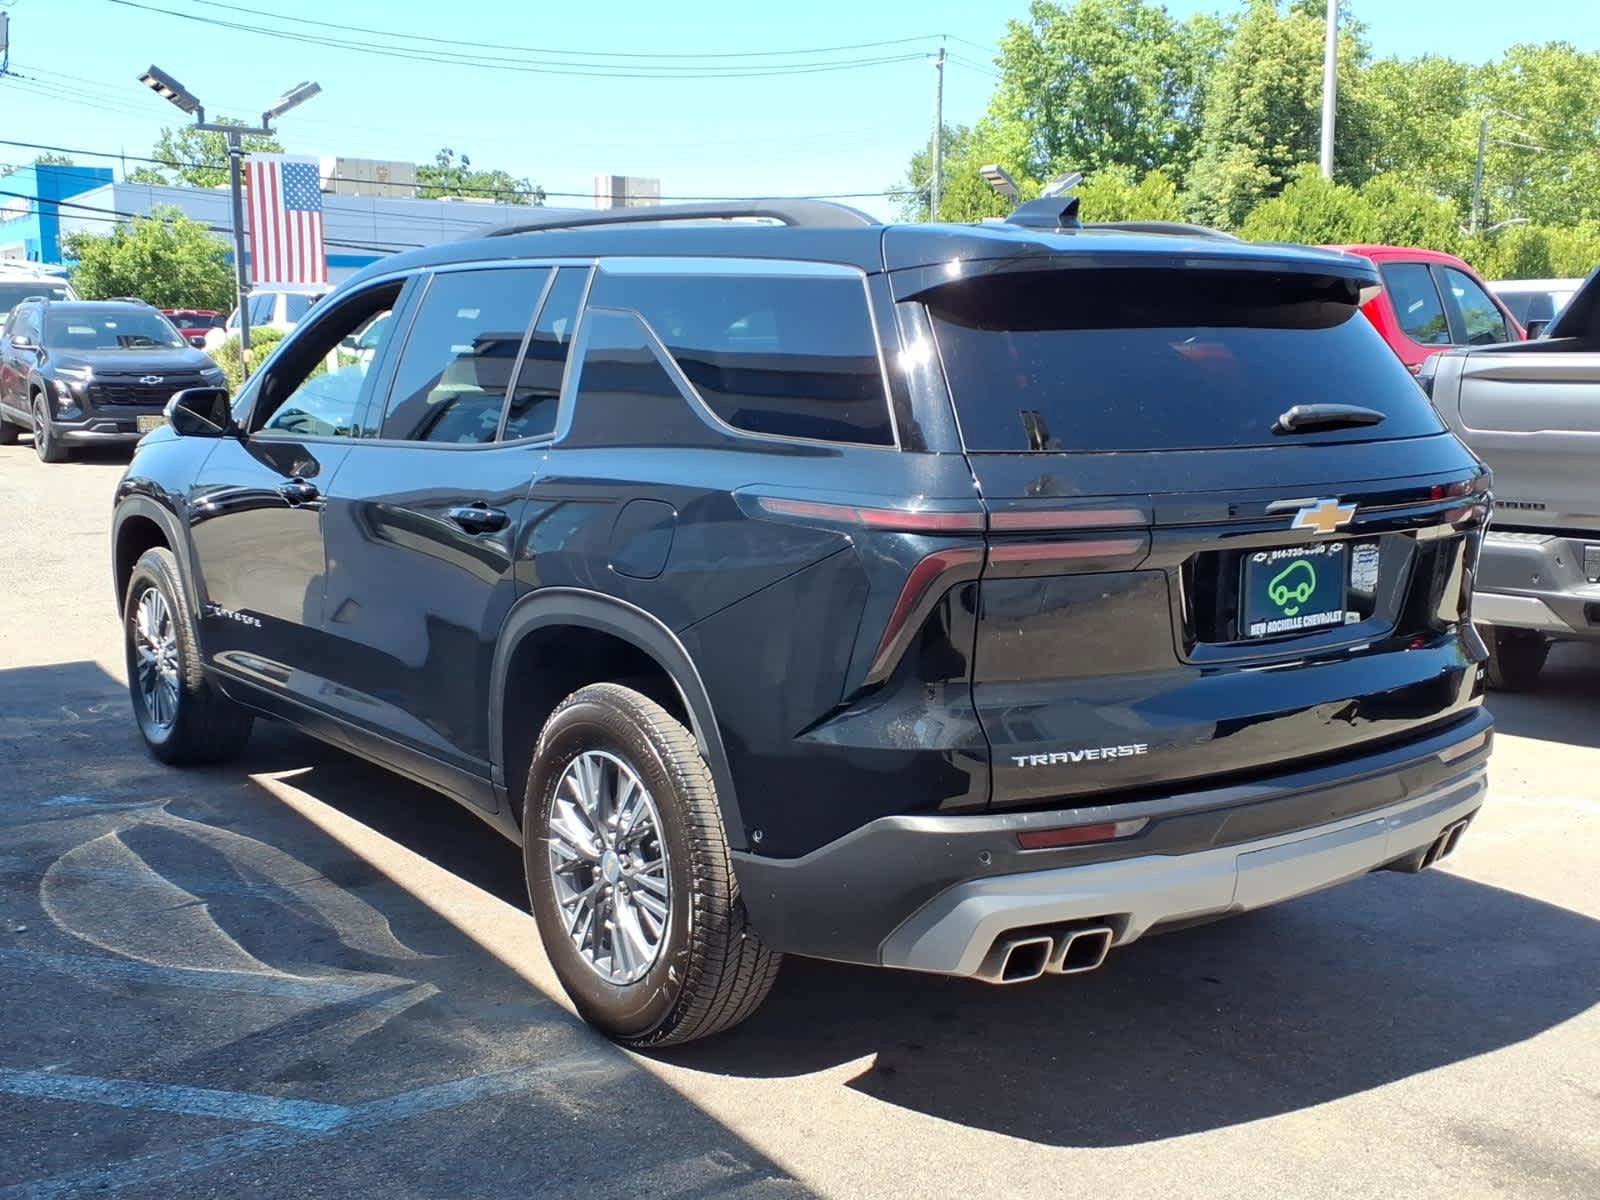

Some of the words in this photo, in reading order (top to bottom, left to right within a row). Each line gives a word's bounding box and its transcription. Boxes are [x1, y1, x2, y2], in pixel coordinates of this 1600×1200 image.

[1251, 622, 1267, 636] NEW
[1267, 615, 1304, 633] ROCHELLE
[1303, 610, 1343, 628] CHEVROLET
[1011, 743, 1149, 768] TRAVERSE
